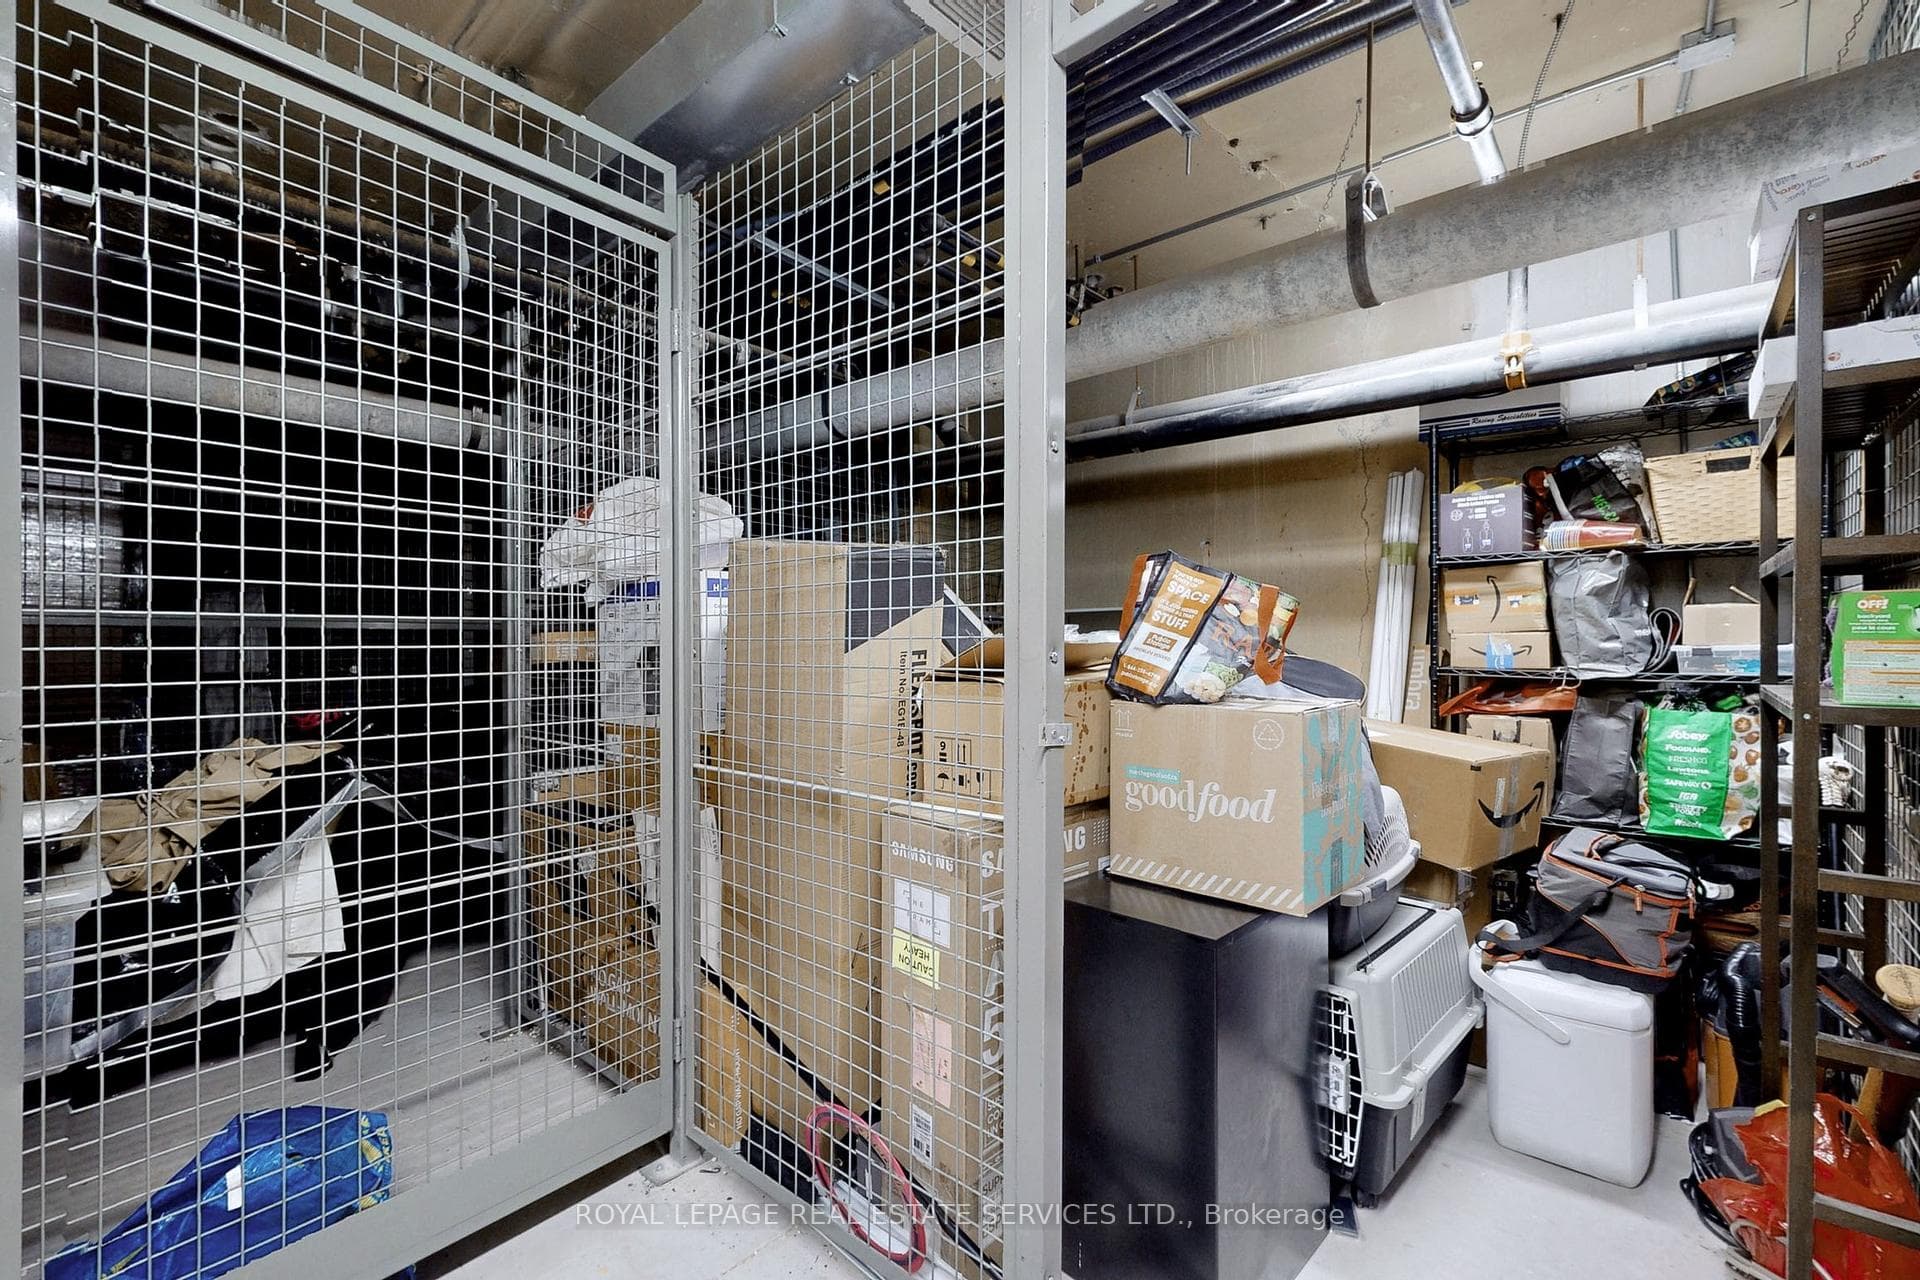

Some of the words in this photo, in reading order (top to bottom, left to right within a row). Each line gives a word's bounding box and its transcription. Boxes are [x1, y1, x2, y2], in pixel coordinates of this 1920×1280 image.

[1167, 580, 1211, 604] SPACE
[1857, 599, 1889, 610] OFF!
[1151, 609, 1189, 631] STUFF
[1125, 780, 1277, 824] goodfood
[891, 841, 955, 873] SAMSUNG
[898, 953, 934, 977] CAUTON
